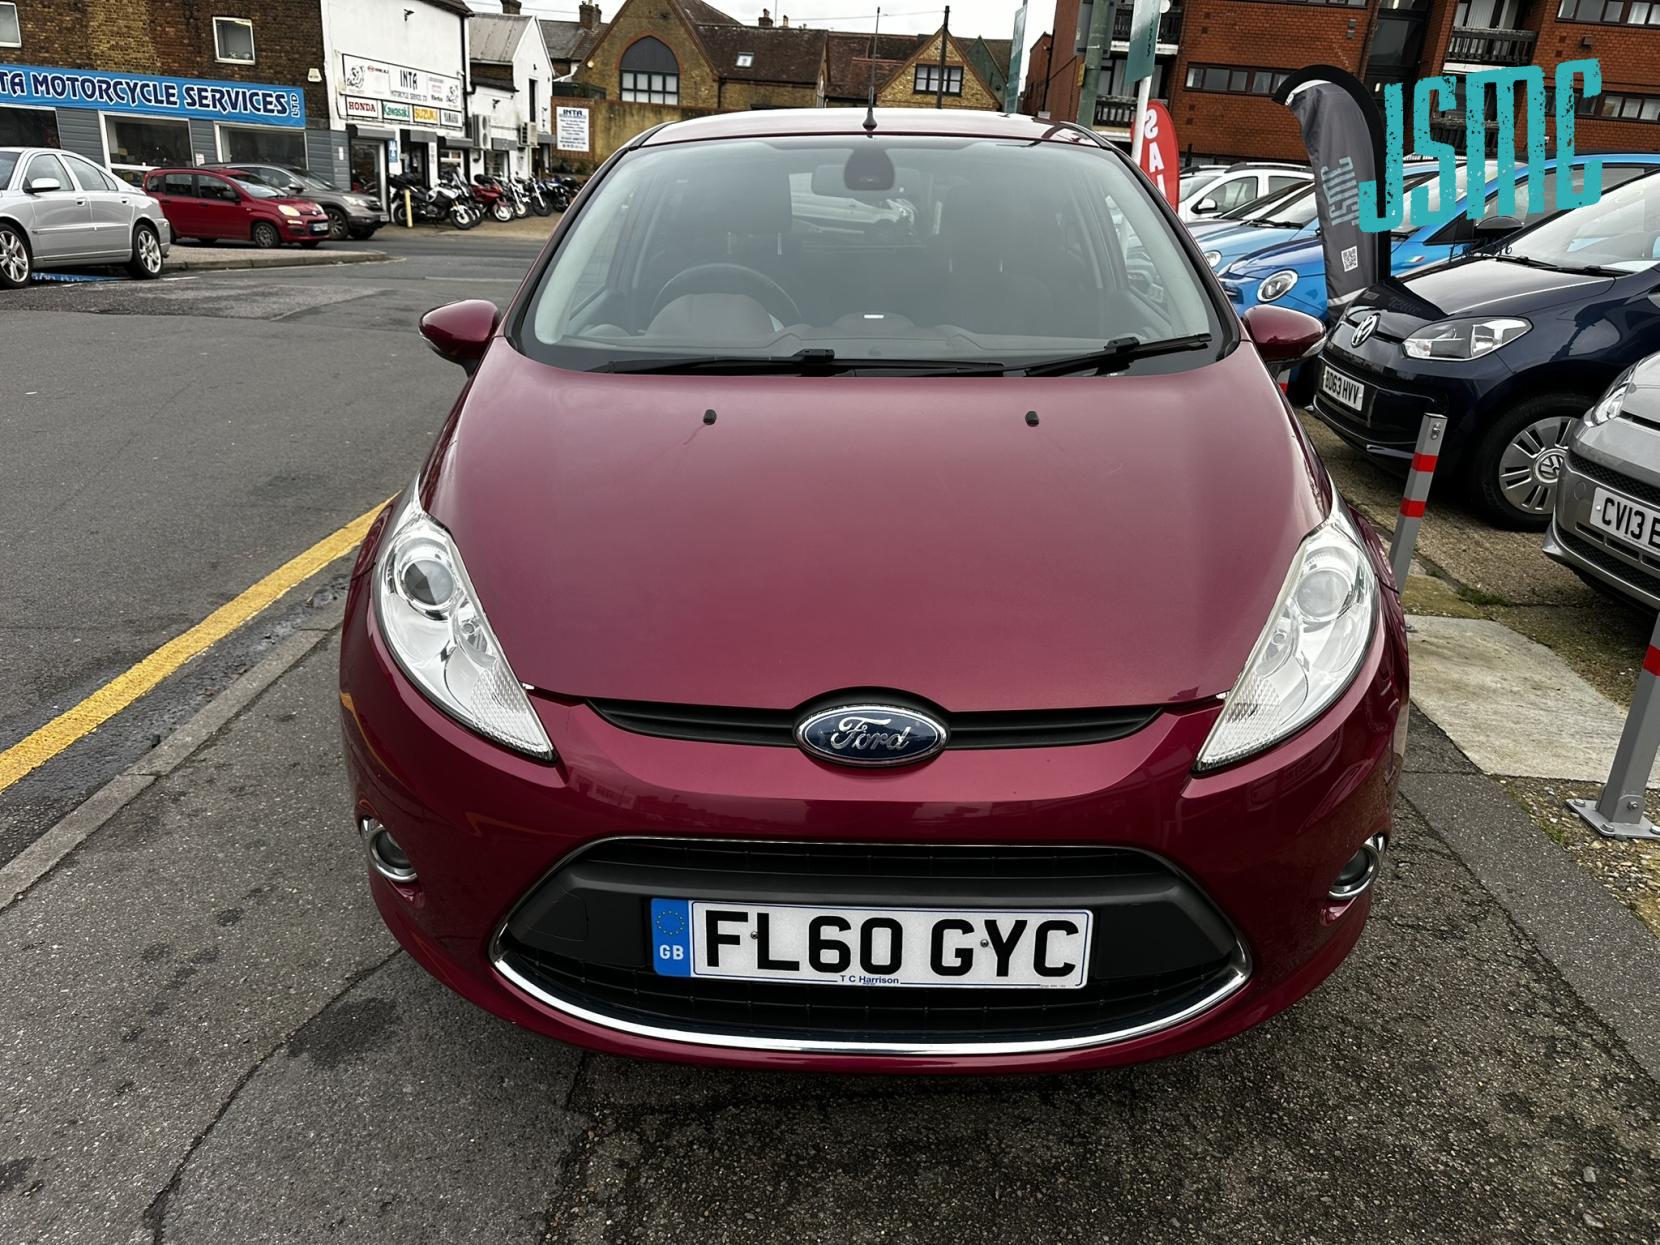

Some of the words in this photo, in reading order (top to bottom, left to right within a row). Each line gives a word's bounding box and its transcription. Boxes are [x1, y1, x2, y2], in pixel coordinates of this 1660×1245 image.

[399, 69, 418, 90] INTA
[30, 72, 178, 107] MOTORCYCLE
[183, 85, 289, 116] SERVICES
[290, 94, 299, 117] LTD
[348, 101, 376, 112] HONDA
[563, 109, 583, 117] INTA
[1342, 380, 1359, 404] HVV
[1602, 497, 1646, 540] CV13
[830, 716, 911, 750] Ford
[659, 944, 684, 960] GB
[705, 909, 902, 976] FL60
[930, 918, 1079, 977] GYC
[848, 975, 856, 983] C
[859, 976, 899, 984] Harrison
